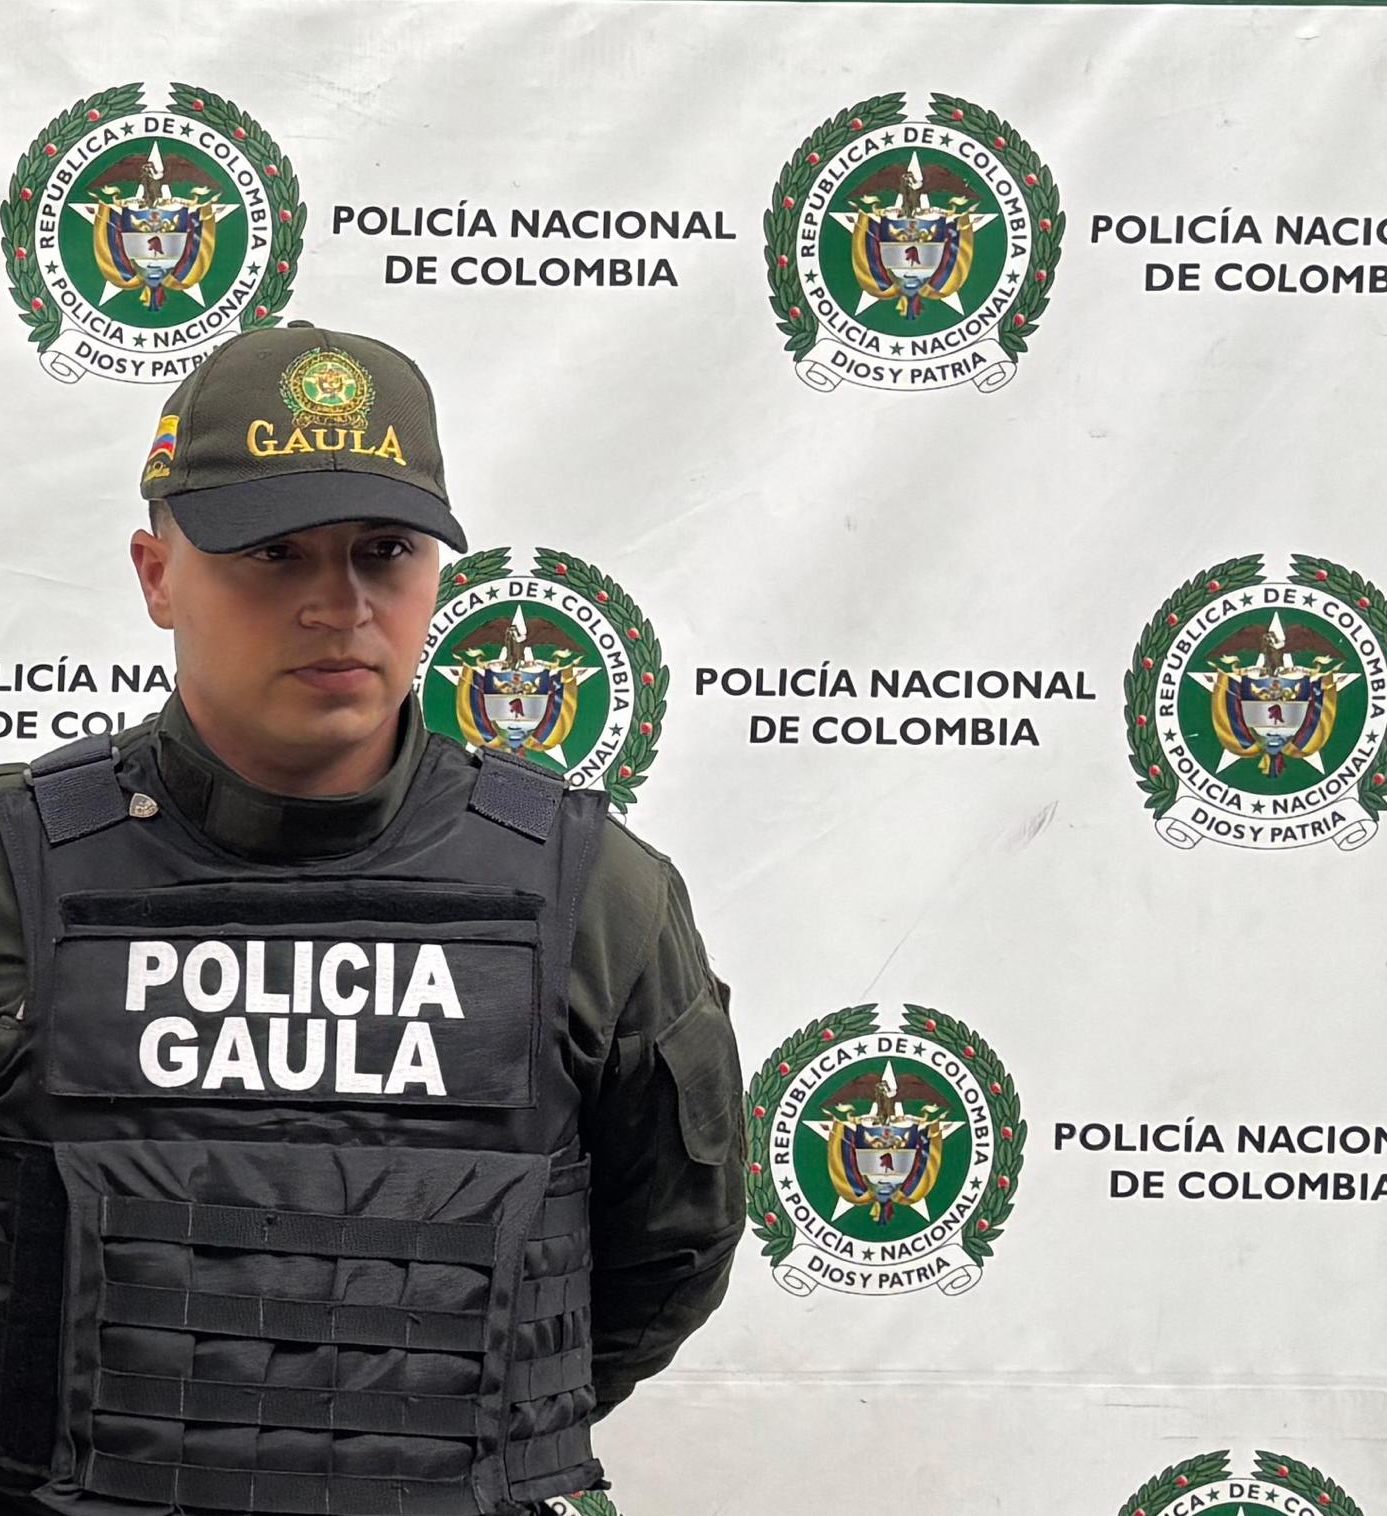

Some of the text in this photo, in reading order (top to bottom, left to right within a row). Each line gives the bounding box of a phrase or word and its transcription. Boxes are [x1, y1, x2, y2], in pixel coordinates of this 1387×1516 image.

[904, 127, 934, 144] DE
[959, 142, 1027, 258] COLOMBIA
[333, 200, 736, 239] POLICÍA NACIONAL
[1091, 207, 1261, 244] POLICÍA
[386, 256, 678, 286] DE COLOMBIA
[1146, 264, 1200, 291] DE
[912, 288, 1015, 356] NACIONAL
[831, 351, 884, 381] DIOS
[911, 352, 986, 384] PATRIA
[246, 419, 406, 466] GAULA
[696, 661, 1095, 699] POLICÍA NACIONAL
[750, 716, 1039, 746] DE COLOMBIA
[125, 940, 465, 1019] POLICIA
[139, 1016, 447, 1096] GAULA
[878, 1038, 908, 1053] DE
[931, 1051, 989, 1165] COLOMBIA
[1055, 1117, 1224, 1152] POLICÍA
[1111, 1171, 1164, 1198] DE
[881, 1193, 978, 1261] NACIONAL
[808, 1256, 856, 1286] DIOS
[879, 1257, 950, 1288] PATRIA
